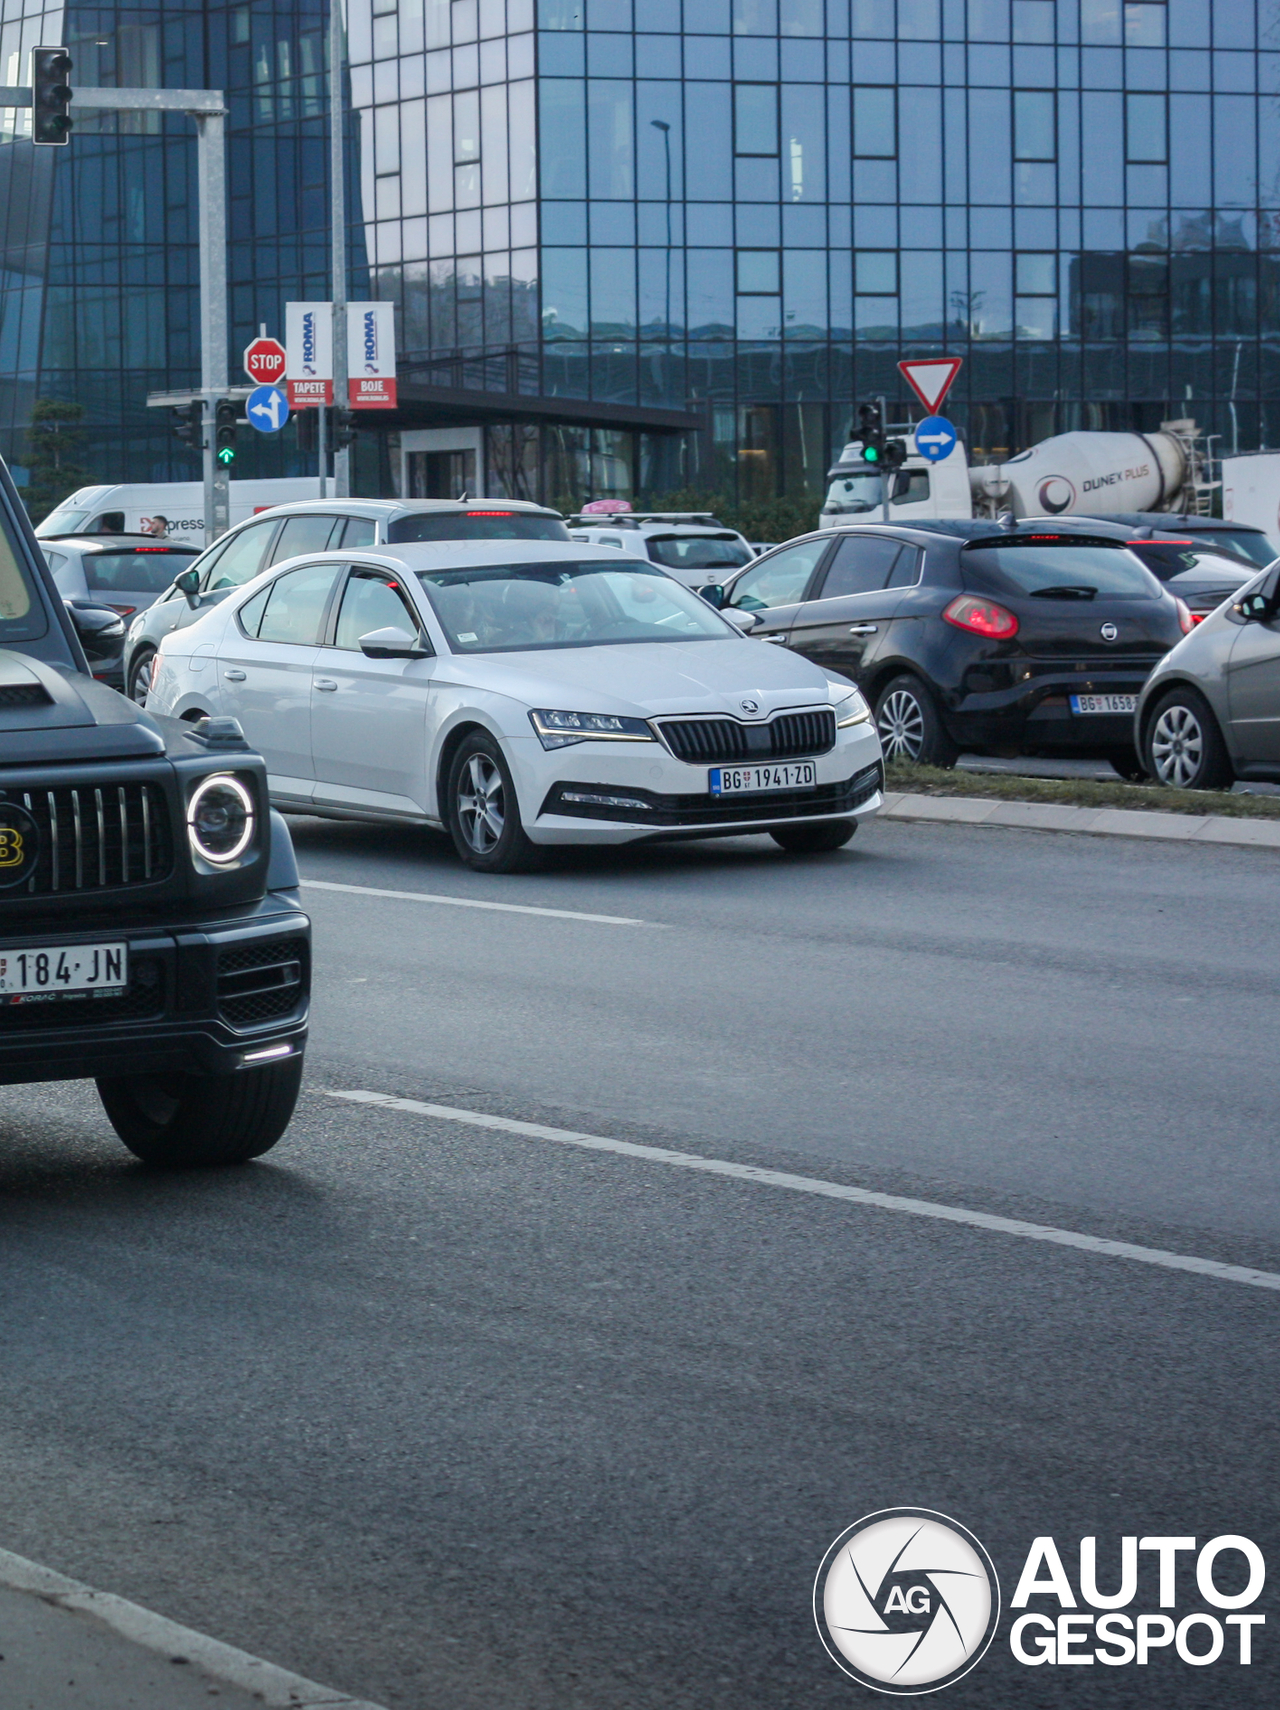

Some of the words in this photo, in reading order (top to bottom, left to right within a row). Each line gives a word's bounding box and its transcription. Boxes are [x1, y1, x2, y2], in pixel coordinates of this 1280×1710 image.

[302, 311, 314, 362] ROMA
[364, 310, 375, 361] ROMA
[251, 354, 282, 370] STOP
[293, 382, 325, 393] TAPETE
[361, 381, 384, 392] BOJE
[1083, 471, 1123, 492] DUNEX
[1125, 464, 1150, 481] PLUS
[1080, 697, 1095, 711] BG
[723, 771, 741, 790] BG
